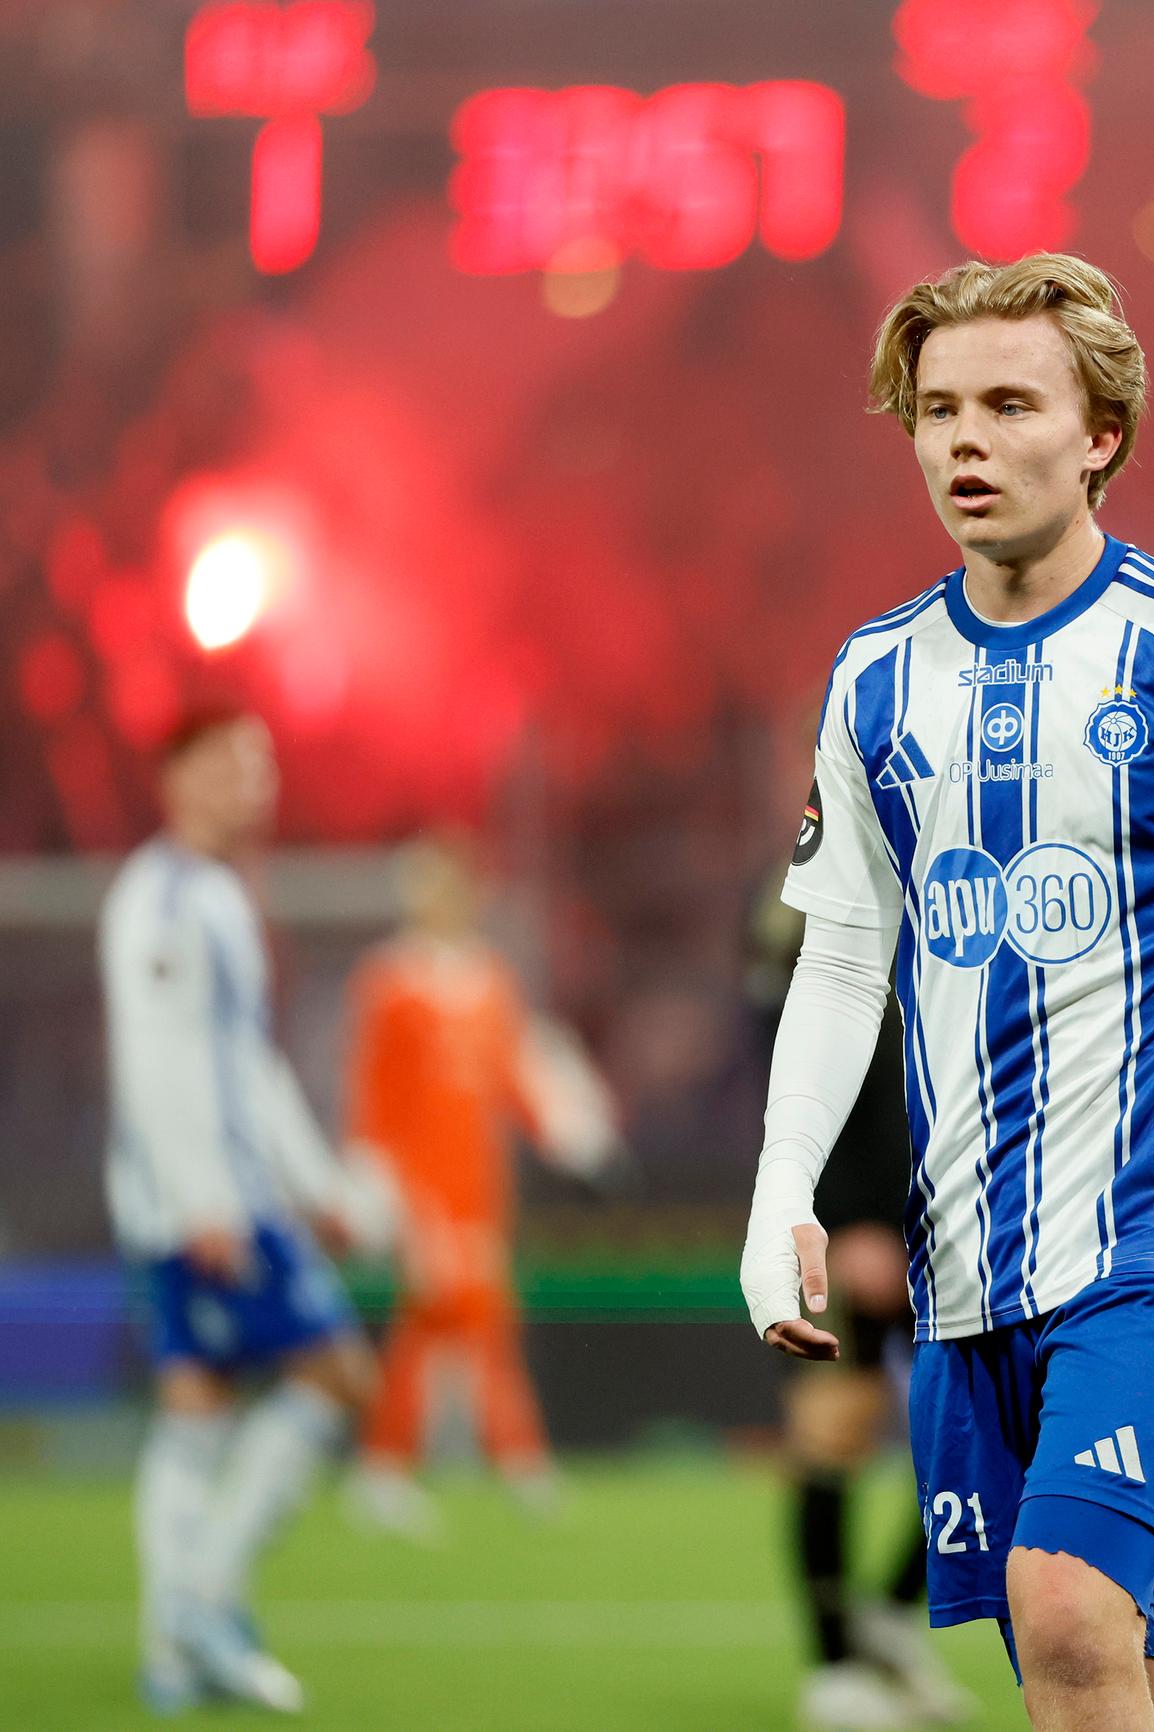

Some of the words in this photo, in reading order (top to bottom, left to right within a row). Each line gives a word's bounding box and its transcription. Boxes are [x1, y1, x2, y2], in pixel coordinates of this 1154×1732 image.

[957, 659, 1053, 687] stadium
[1100, 726, 1135, 747] HJK
[1108, 751, 1126, 761] 1907
[949, 760, 972, 784] OP
[977, 758, 1054, 783] Uusimaa
[927, 876, 998, 958] apu
[1015, 872, 1095, 935] 360
[933, 1490, 990, 1554] 21
